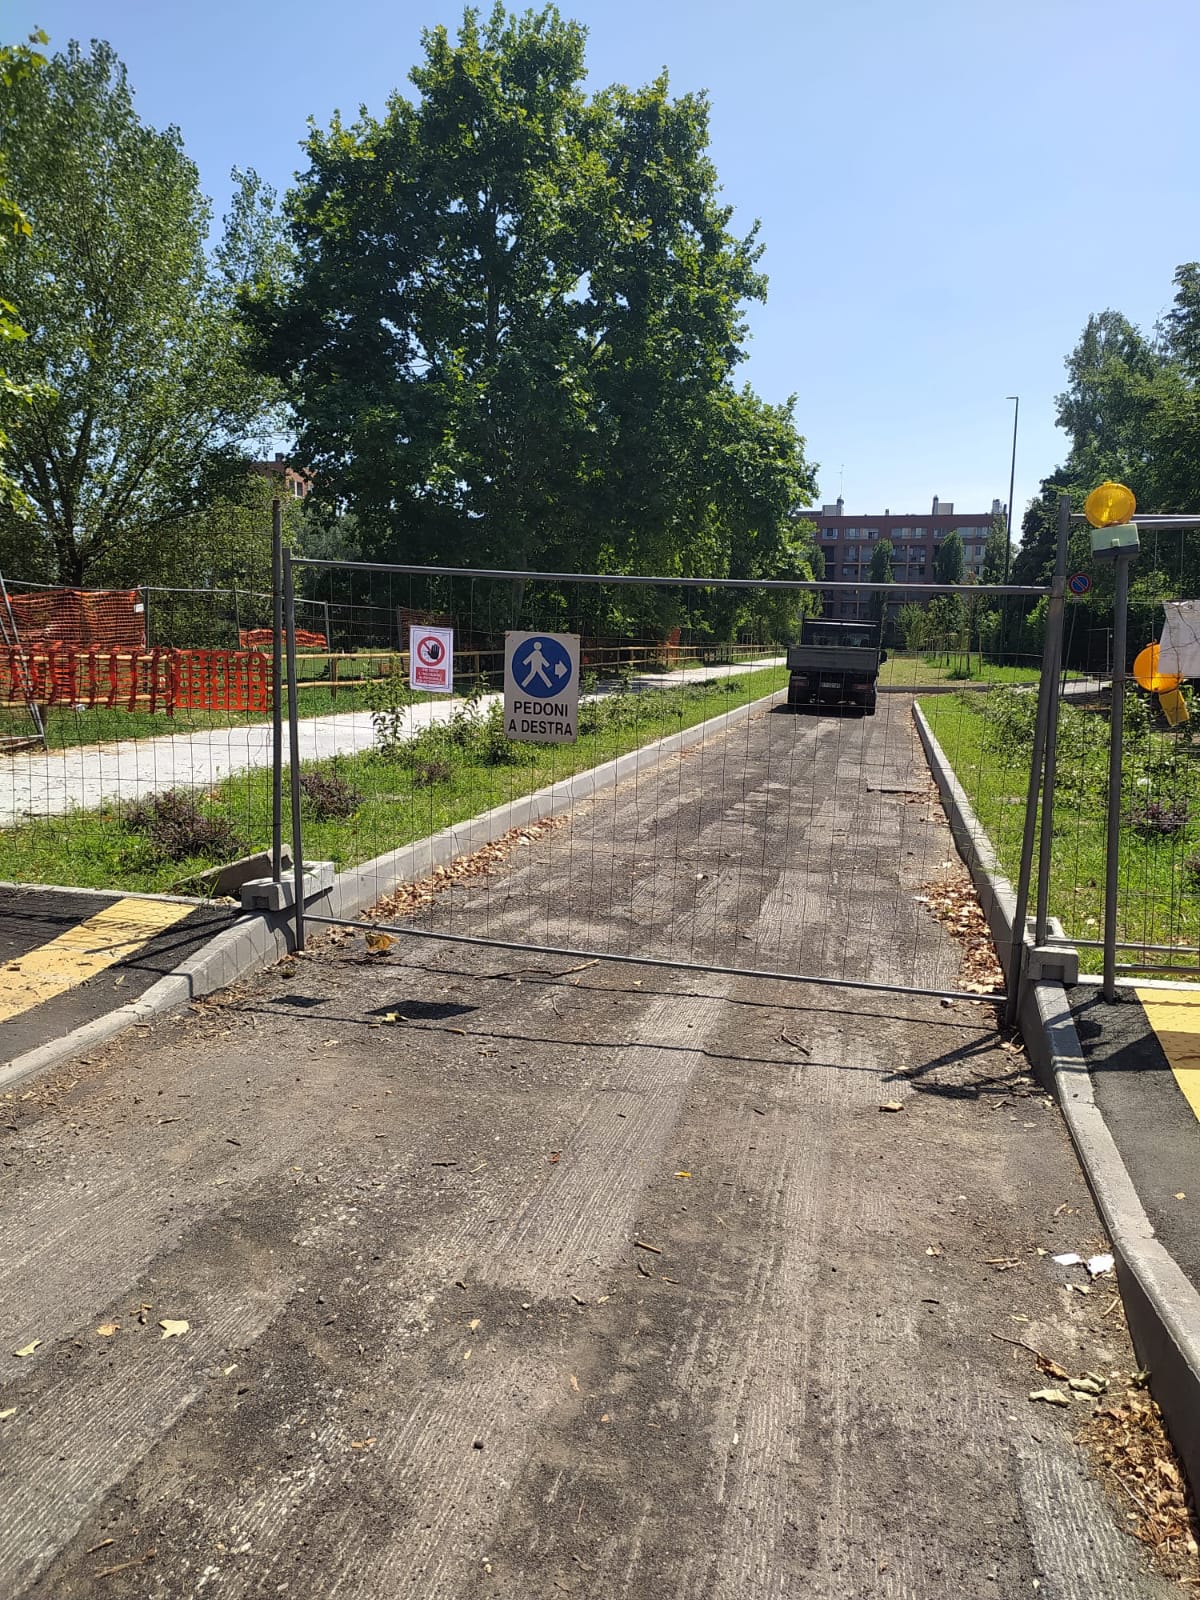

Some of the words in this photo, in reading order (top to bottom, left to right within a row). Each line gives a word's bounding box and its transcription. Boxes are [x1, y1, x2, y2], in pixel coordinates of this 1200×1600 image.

[514, 701, 568, 717] PEDONI
[508, 719, 517, 732] A
[521, 720, 573, 736] DESTRA
